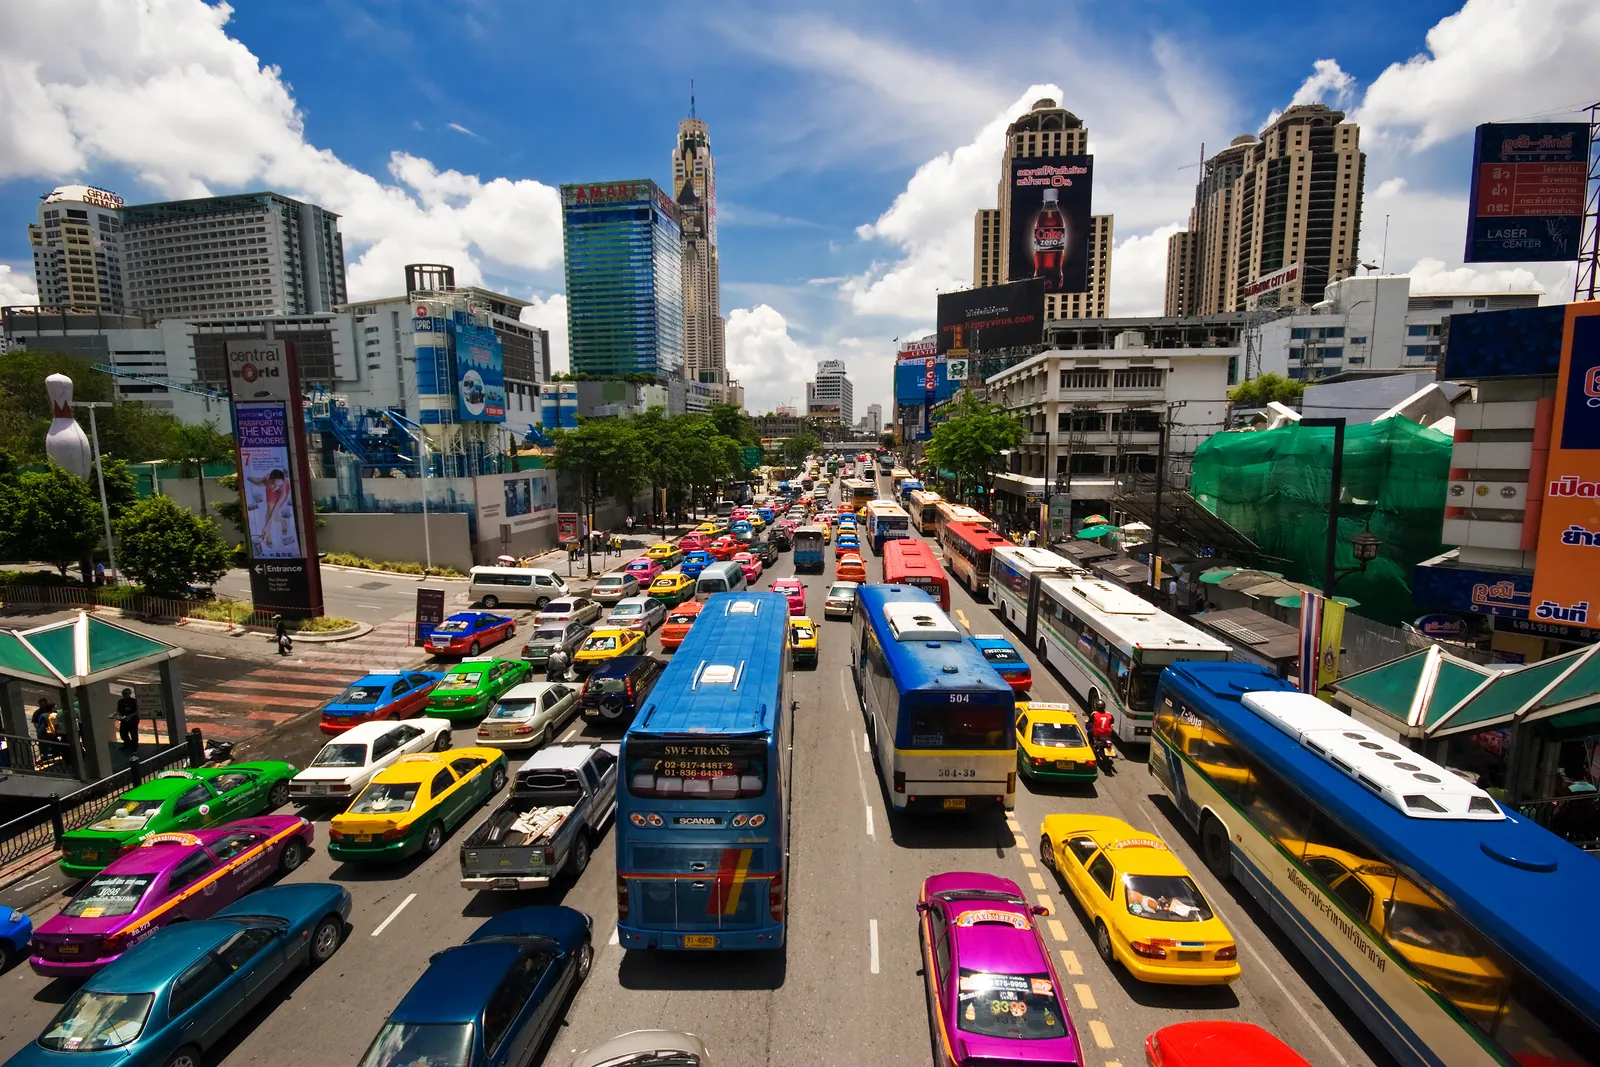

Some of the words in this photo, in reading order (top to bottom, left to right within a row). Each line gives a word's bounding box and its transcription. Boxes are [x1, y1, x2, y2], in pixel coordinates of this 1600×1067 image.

[1493, 168, 1510, 179] สิว
[87, 189, 124, 204] GRAND
[576, 184, 637, 199] AMARI
[83, 195, 122, 209] DIAMO
[1035, 229, 1064, 240] Coke
[1487, 229, 1528, 239] LASER
[1502, 240, 1541, 248] CENTER
[1271, 272, 1286, 288] CITY
[416, 319, 431, 330] CPAC
[230, 348, 280, 361] central
[240, 426, 260, 436] THE
[261, 426, 284, 436] NEW
[240, 436, 248, 447] 7
[248, 437, 285, 445] WONDERS
[241, 452, 251, 467] 7
[1549, 476, 1600, 498] เปิด
[266, 565, 303, 573] Entrance
[1535, 600, 1589, 624] วันที่
[949, 694, 970, 703] 504
[1100, 717, 1107, 729] 7
[1181, 706, 1202, 731] 7-3018
[664, 745, 730, 756] SWE-TRANS
[664, 761, 733, 770] 02-617-4481-2
[938, 769, 976, 777] 504-39
